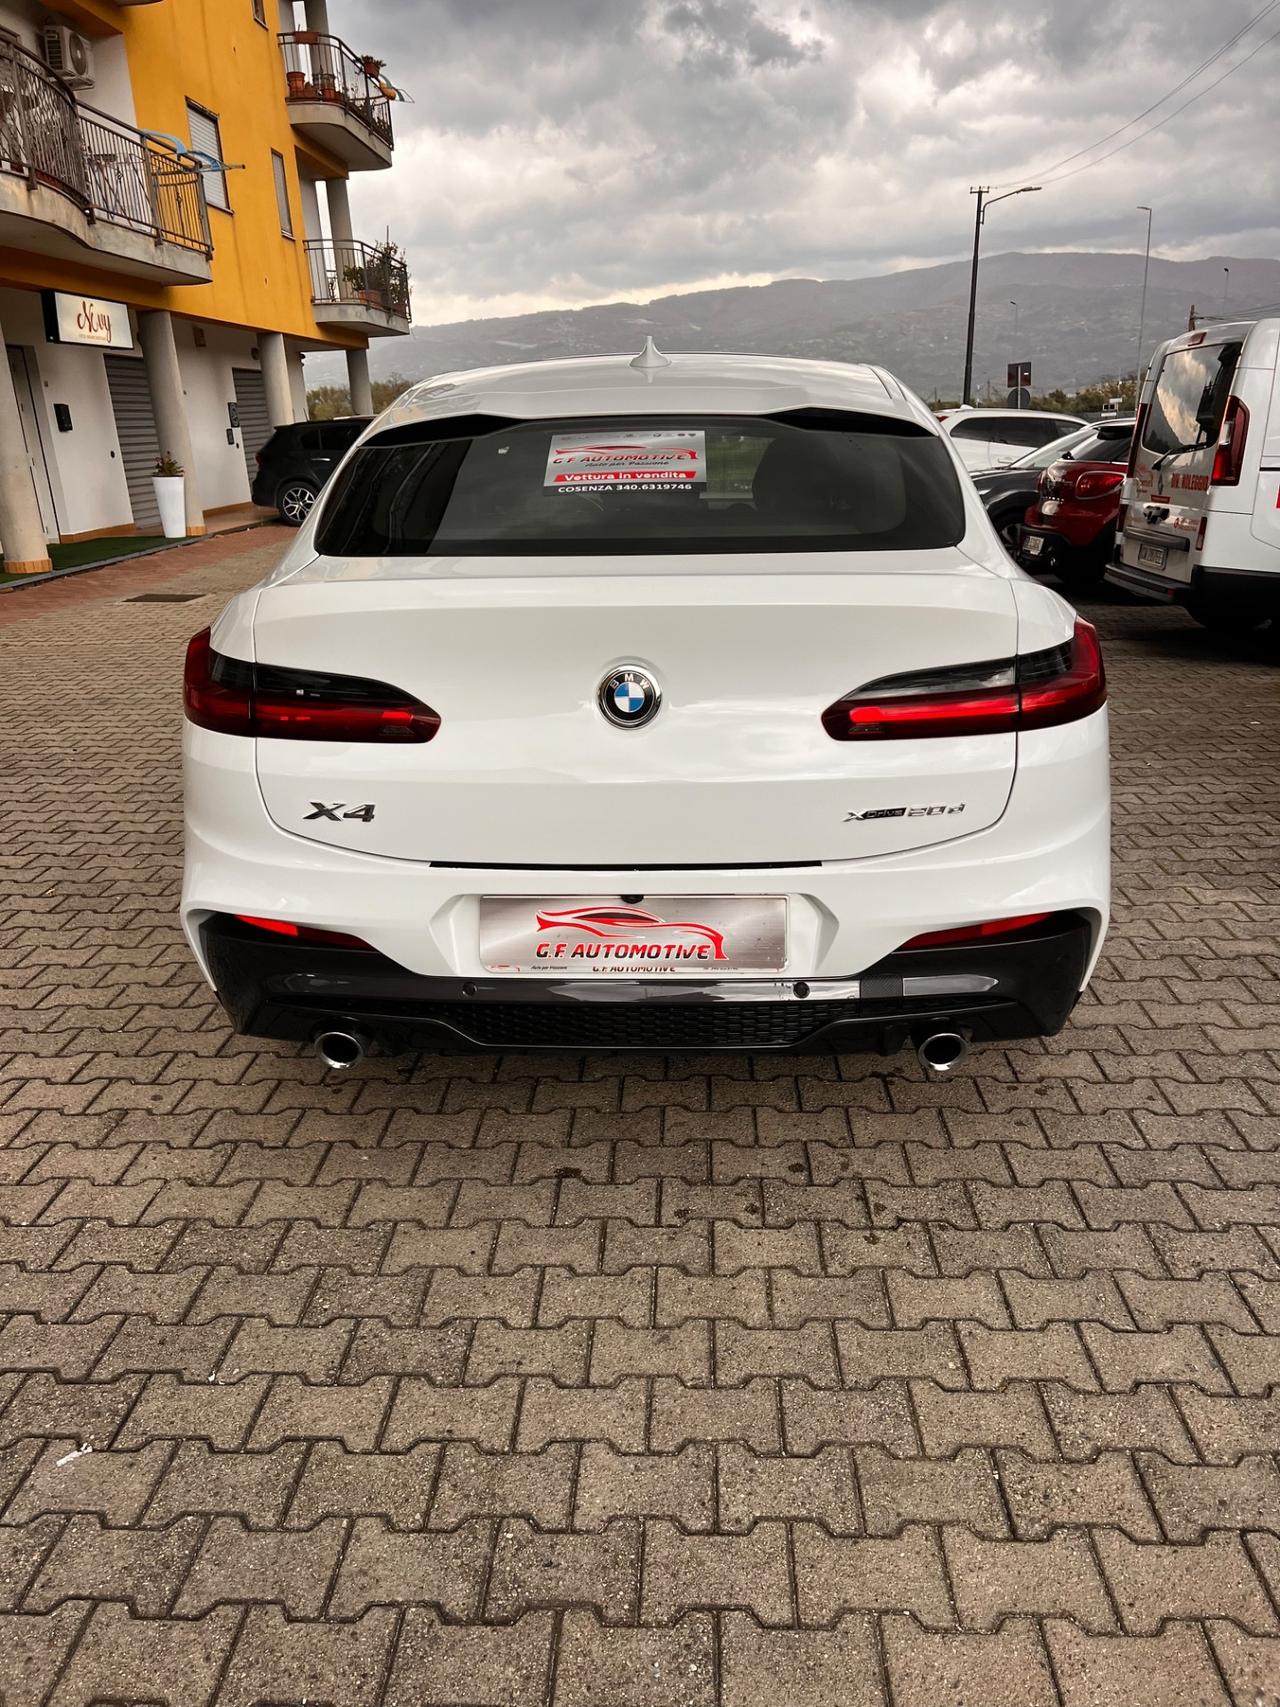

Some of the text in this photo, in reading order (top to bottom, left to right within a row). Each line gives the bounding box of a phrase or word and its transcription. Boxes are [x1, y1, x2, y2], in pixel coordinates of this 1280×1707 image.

[580, 454, 686, 462] AUTOMOTIVE
[565, 471, 687, 481] Vettura in vendita
[558, 483, 692, 493] COSENZA 340.6319746
[610, 673, 651, 689] BMW
[303, 802, 376, 822] X4
[571, 944, 711, 959] AUTOMOTIVE
